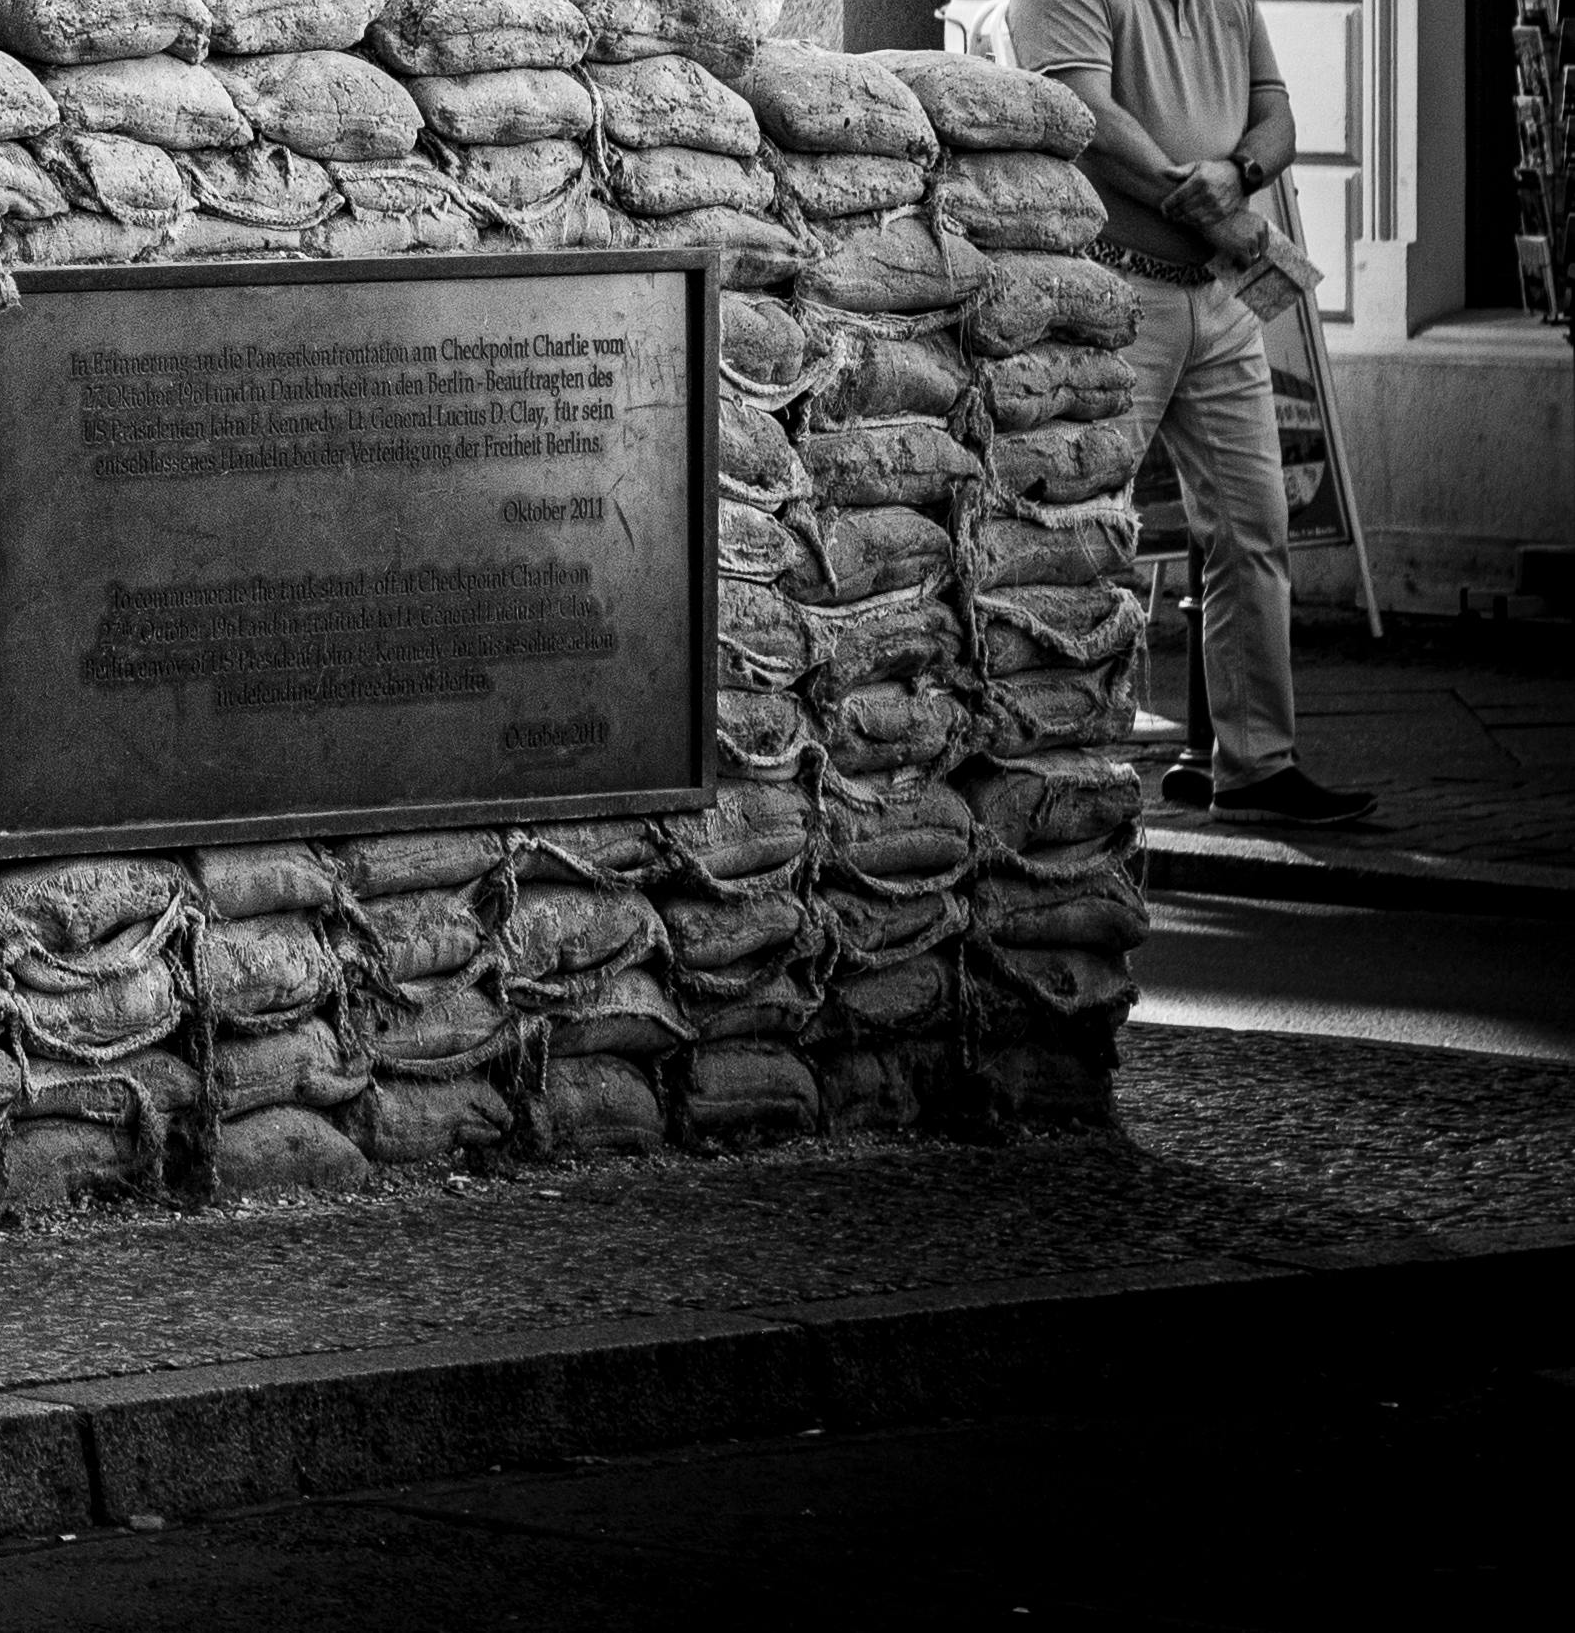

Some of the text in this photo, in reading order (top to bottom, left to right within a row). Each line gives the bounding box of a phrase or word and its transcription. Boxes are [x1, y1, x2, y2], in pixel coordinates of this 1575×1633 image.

[71, 351, 87, 376] In
[93, 350, 189, 379] Erinnerung
[217, 346, 241, 370] die
[248, 342, 408, 370] Panzerkonfrontation
[414, 345, 437, 363] am
[441, 336, 529, 367] Checkpoint
[533, 334, 589, 358] Charlie
[592, 337, 625, 357] vom
[107, 381, 172, 409] Oktober
[177, 380, 210, 407] 1961
[211, 381, 246, 405] und
[248, 379, 267, 403] in
[270, 375, 369, 402] Dankbarkeit
[371, 379, 391, 399] an
[395, 372, 424, 396] den
[588, 365, 614, 388] des
[83, 418, 107, 445] US
[111, 415, 205, 443] Präsidenten
[210, 411, 246, 441] John
[371, 405, 431, 430] General
[437, 403, 487, 427] Lucius
[490, 401, 507, 425] D.
[510, 399, 549, 431] Clay,
[554, 398, 580, 423] für
[582, 397, 615, 422] sein
[94, 430, 604, 478] entschlossenes Handeln bei der Verteidigung der Freiheit Berlins.
[503, 496, 606, 524] Oktober 2011
[134, 585, 250, 611] commemorate
[252, 577, 276, 605] the
[279, 575, 317, 603] tank
[418, 567, 507, 597] Checkpoint
[509, 562, 569, 588] Charlie
[570, 568, 590, 586] on
[139, 617, 202, 645] October
[248, 612, 278, 639] and
[303, 607, 374, 639] gratitude
[420, 602, 481, 628] General
[483, 600, 537, 625] Lucius
[191, 653, 209, 677] of
[238, 645, 312, 674] President
[477, 633, 501, 657] his
[505, 631, 564, 656] resolute
[237, 679, 317, 711] defending
[350, 672, 415, 701] freedom
[418, 671, 438, 694] of
[503, 724, 568, 751] October
